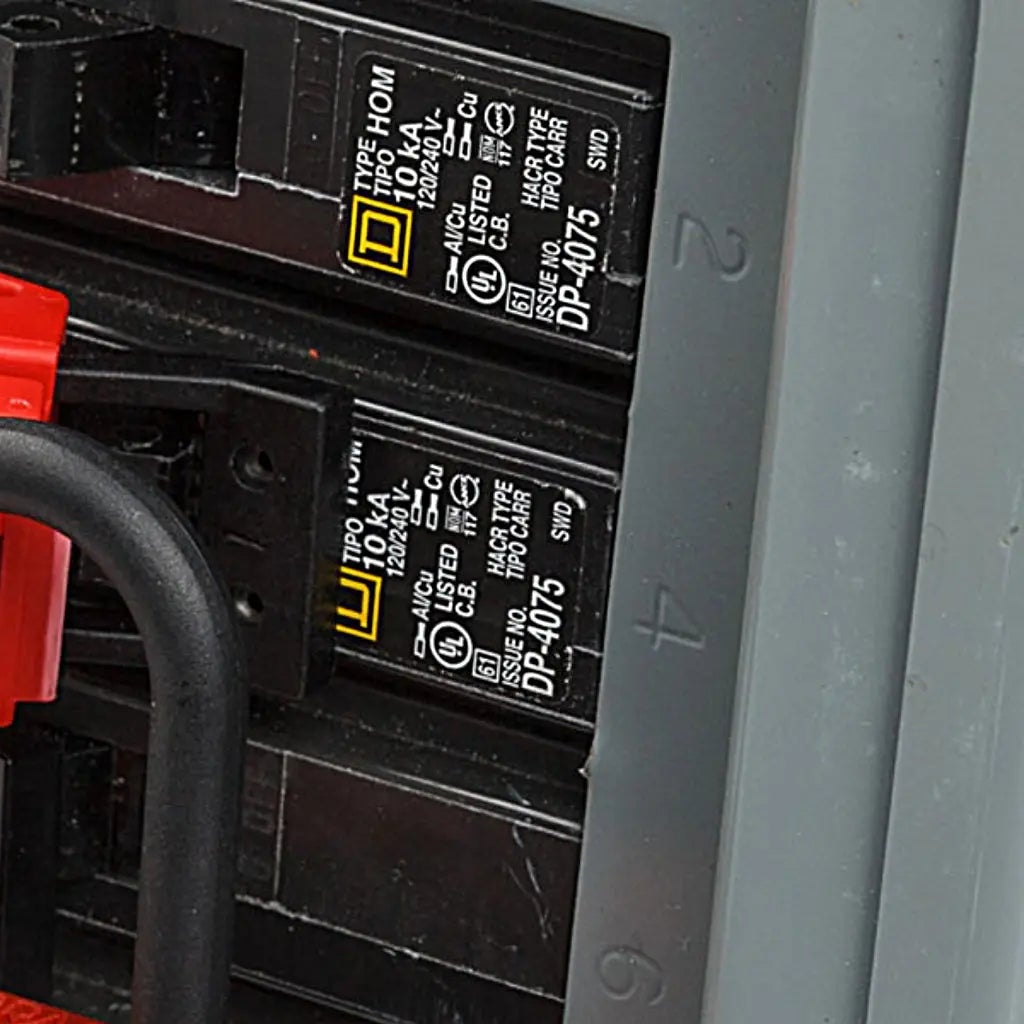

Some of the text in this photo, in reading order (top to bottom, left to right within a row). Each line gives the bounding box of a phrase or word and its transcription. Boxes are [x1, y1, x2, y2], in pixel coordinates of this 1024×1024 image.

[353, 64, 396, 190] TYPE HOM
[457, 92, 479, 119] Cu
[373, 149, 396, 197] TIPO
[393, 121, 423, 202] 10 kA
[416, 139, 441, 210] 120/240
[521, 106, 550, 207] HACR TYPE
[541, 116, 568, 211] TIPO CARR
[587, 128, 610, 171] SWD
[468, 174, 493, 245] LISTED
[488, 212, 511, 251] C.B.
[535, 238, 562, 323] ISSUE NO.
[556, 205, 602, 331] DP-4075
[674, 212, 750, 283] 2
[424, 464, 444, 490] Cu
[342, 517, 364, 563] TIPO
[362, 493, 391, 570] 10 kA
[386, 507, 408, 577] 120/240
[487, 478, 515, 576] HACR TYPE
[505, 489, 531, 580] TIPO CARR
[551, 501, 573, 542] SWD
[434, 544, 459, 612] LISTED
[455, 580, 477, 618] C.B.
[502, 606, 527, 688] ISSUE NO.
[522, 575, 565, 697] DP-4075
[633, 583, 706, 650] 4
[597, 944, 665, 1005] 6
